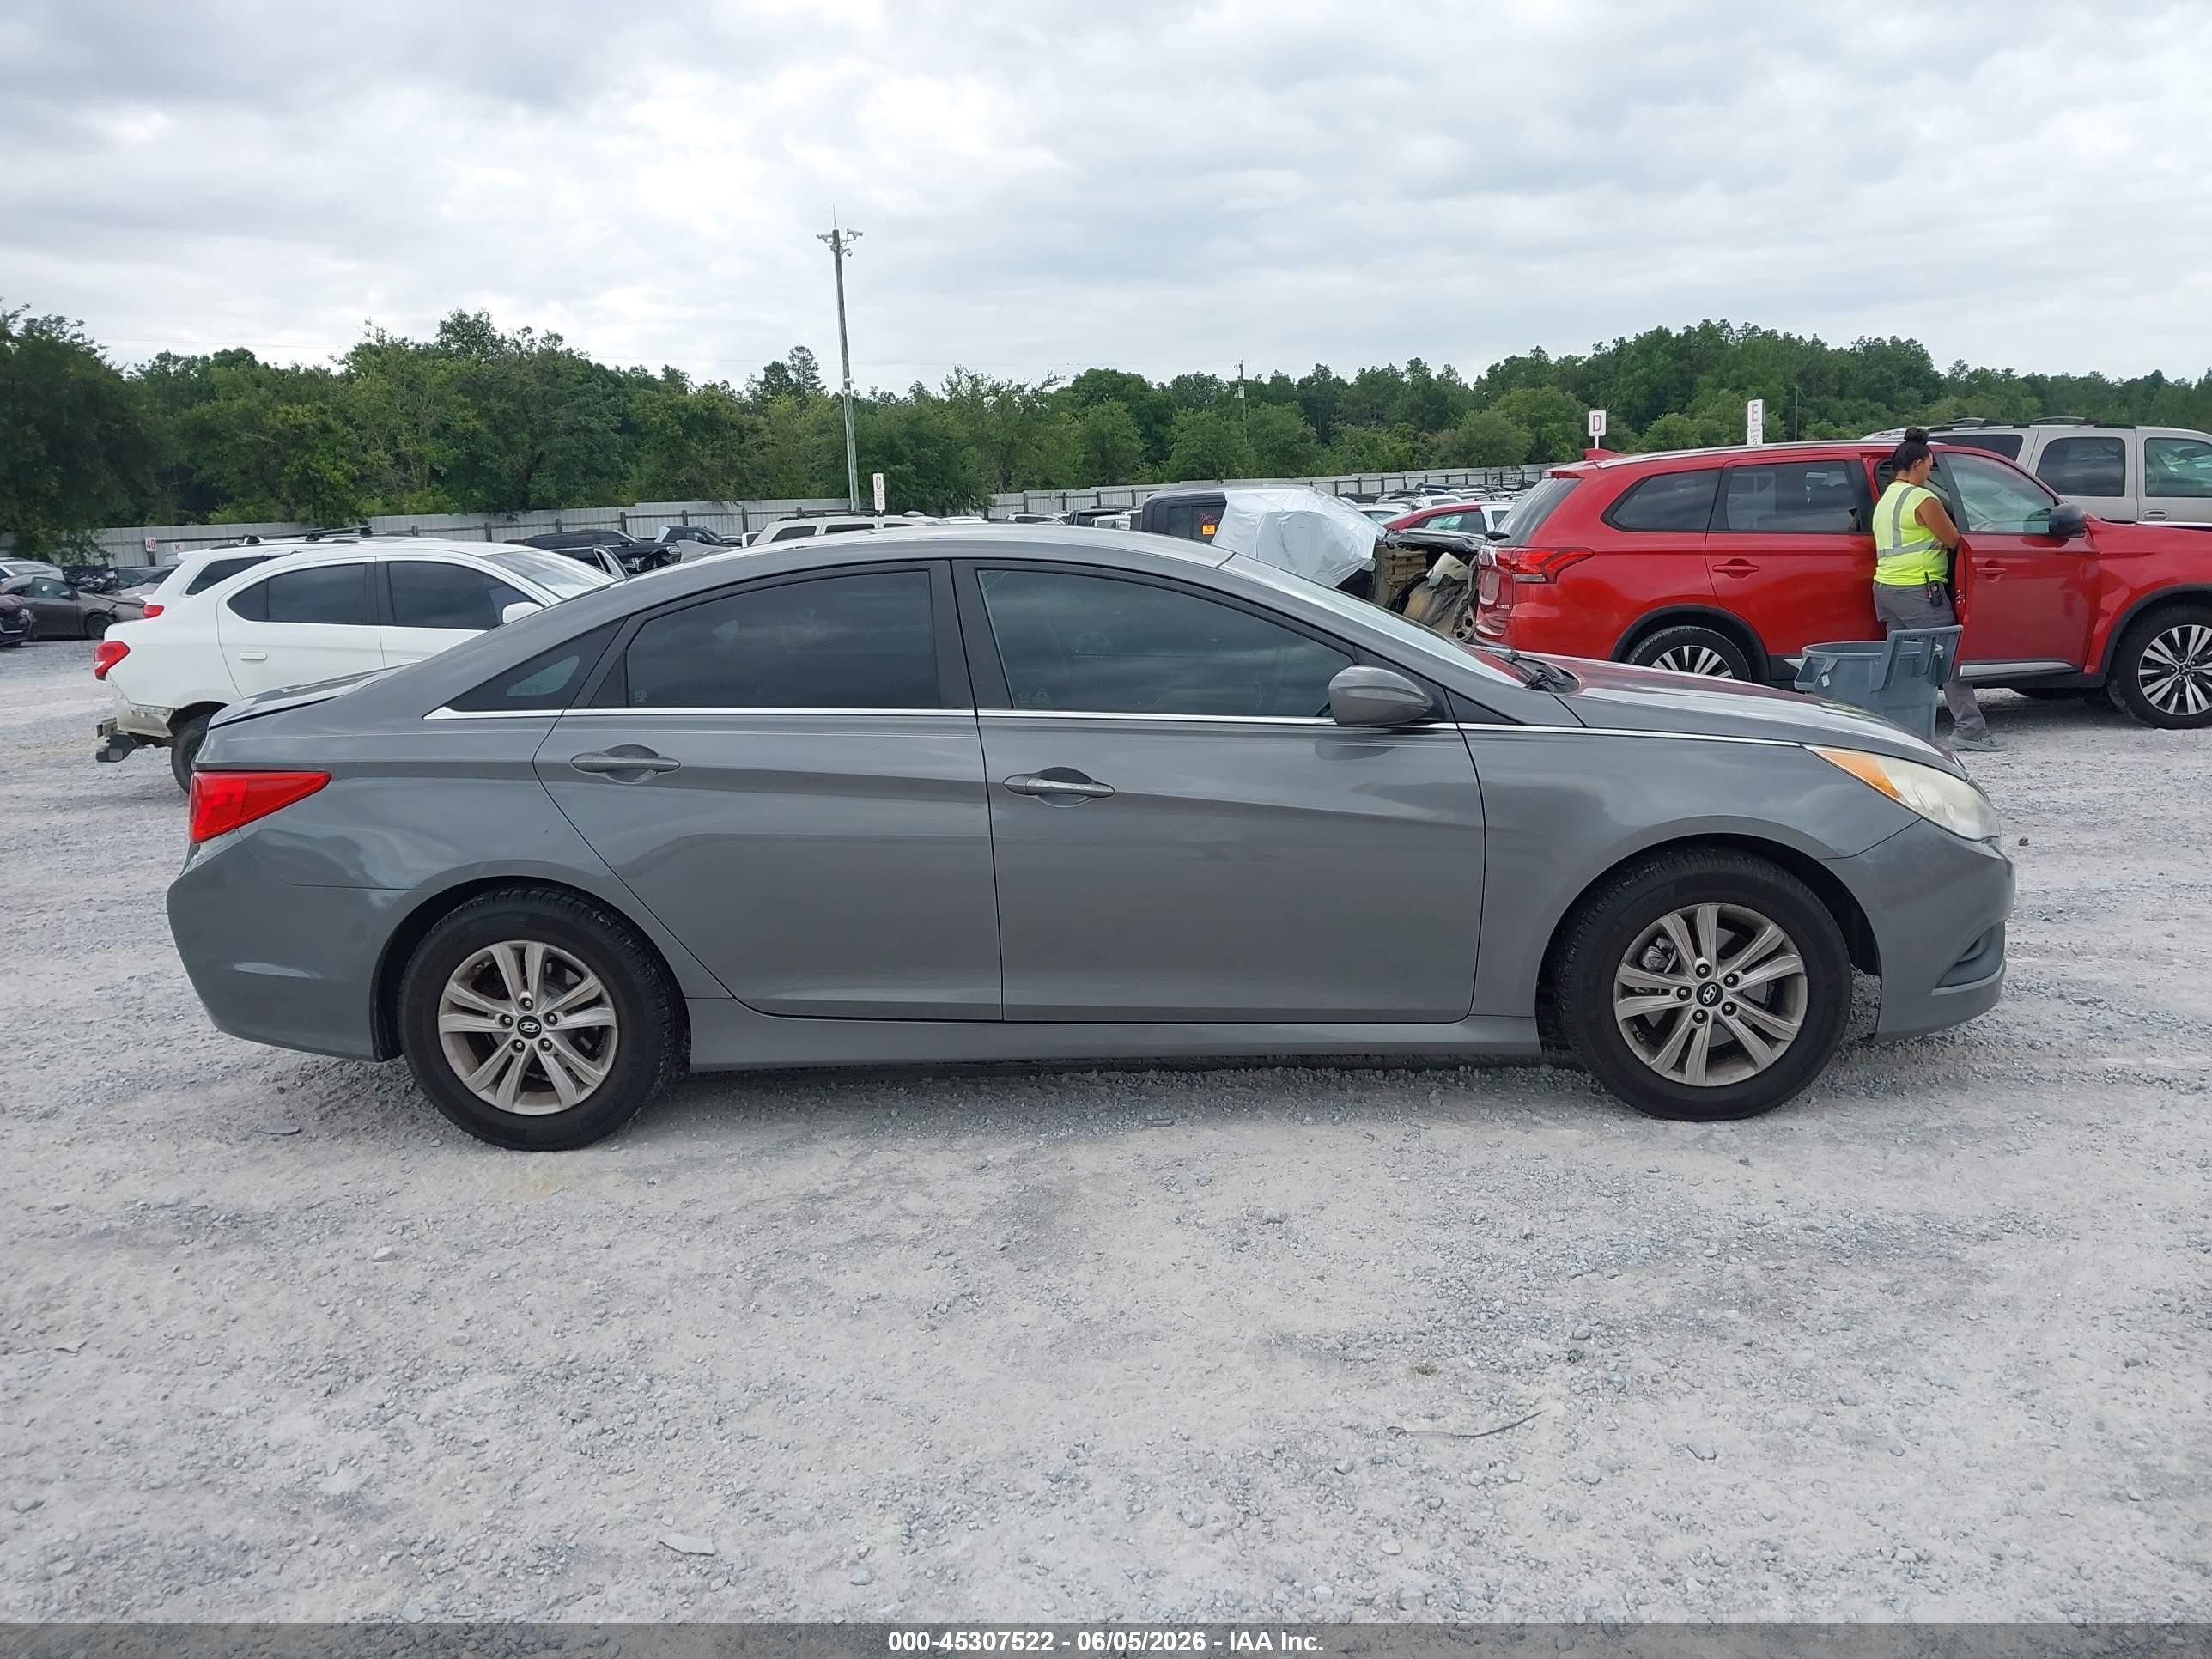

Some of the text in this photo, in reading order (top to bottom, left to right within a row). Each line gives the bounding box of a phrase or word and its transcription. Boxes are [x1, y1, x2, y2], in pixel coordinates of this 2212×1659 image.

[1752, 404, 1758, 422] E
[1593, 415, 1601, 432] D
[147, 538, 155, 550] 40
